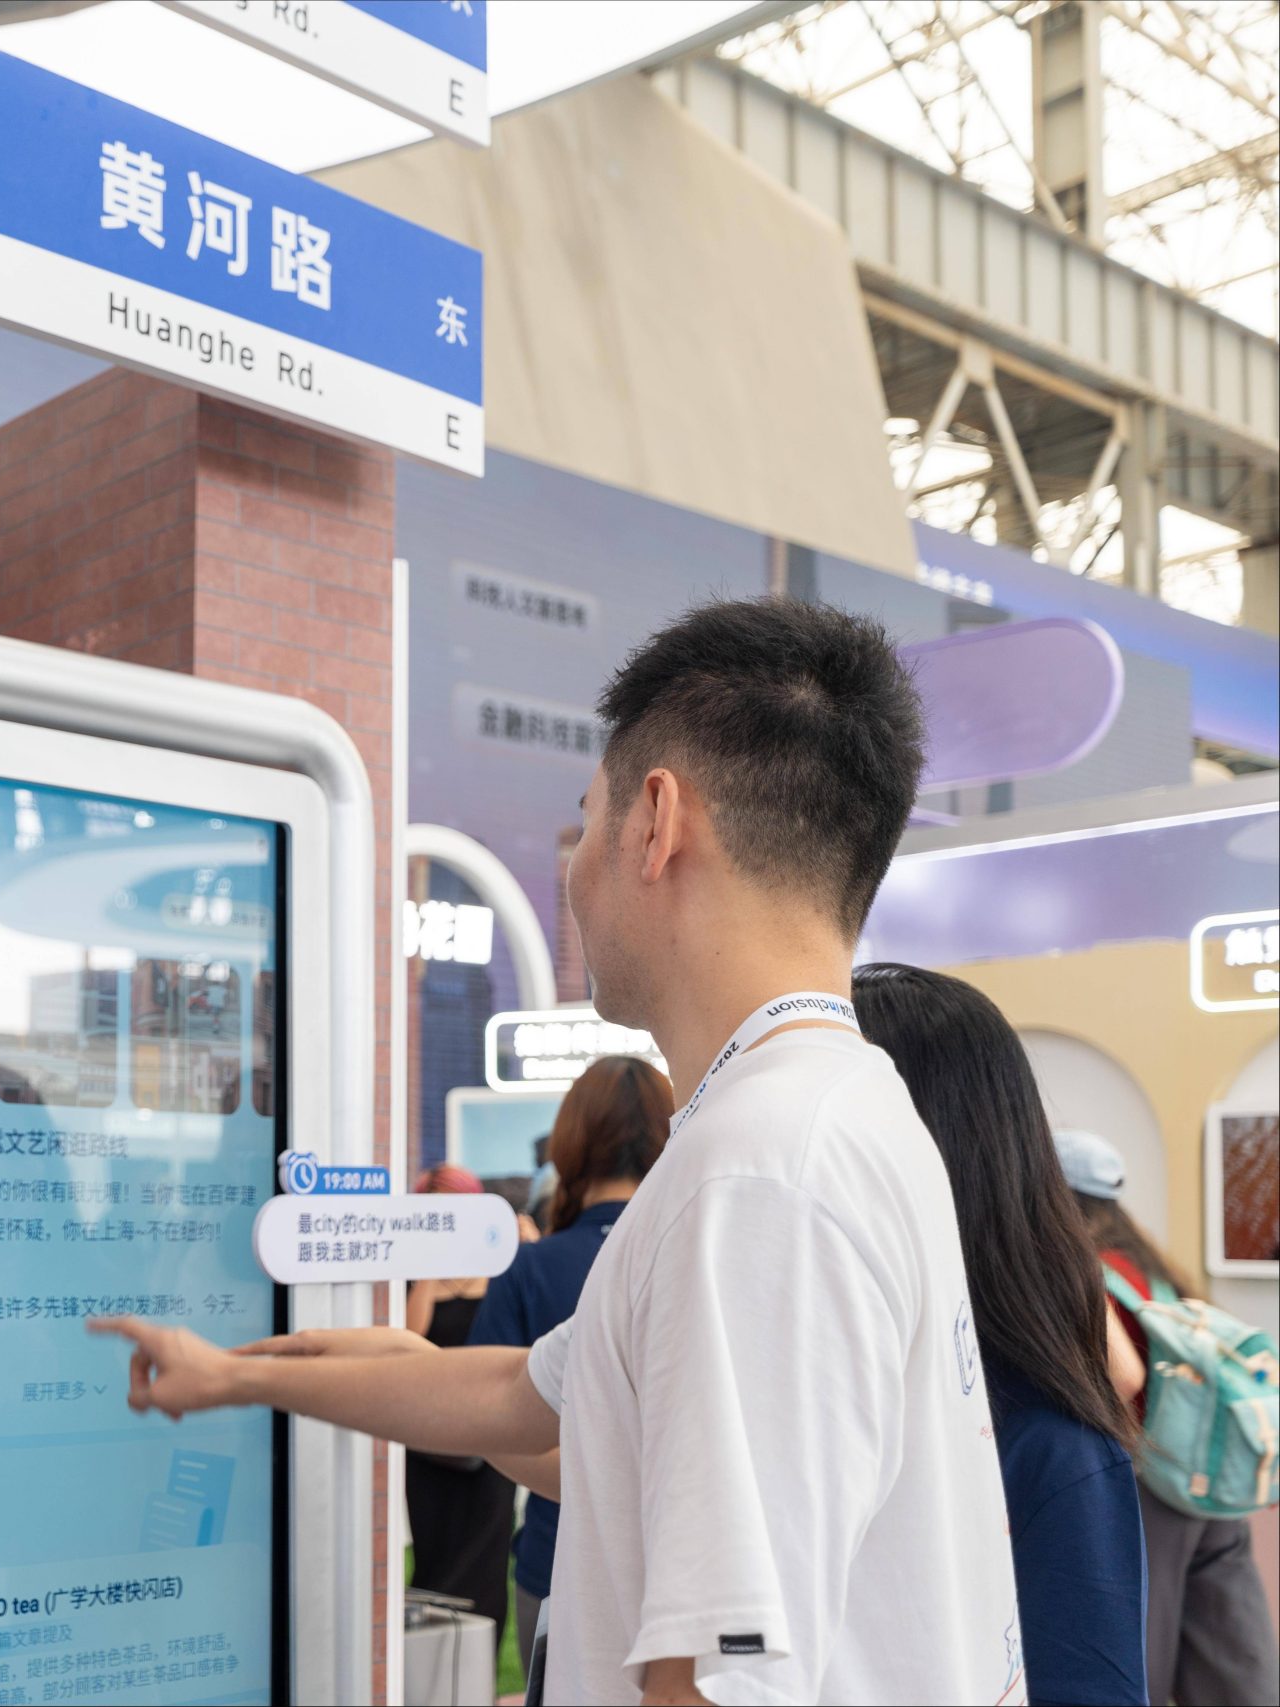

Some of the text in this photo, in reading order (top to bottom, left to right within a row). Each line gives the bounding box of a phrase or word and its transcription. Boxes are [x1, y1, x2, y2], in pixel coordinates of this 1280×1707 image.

[449, 78, 466, 117] E
[99, 140, 333, 311] 黄河路
[436, 295, 468, 348] 东
[109, 292, 323, 396] Huanghe Rd.
[446, 414, 460, 451] E
[323, 1172, 386, 1190] 19:00 AM
[390, 1213, 455, 1233] walk路线
[298, 1241, 394, 1263] 跟我走就对了
[23, 1381, 87, 1402] 展开更多
[13, 1597, 39, 1615] tea
